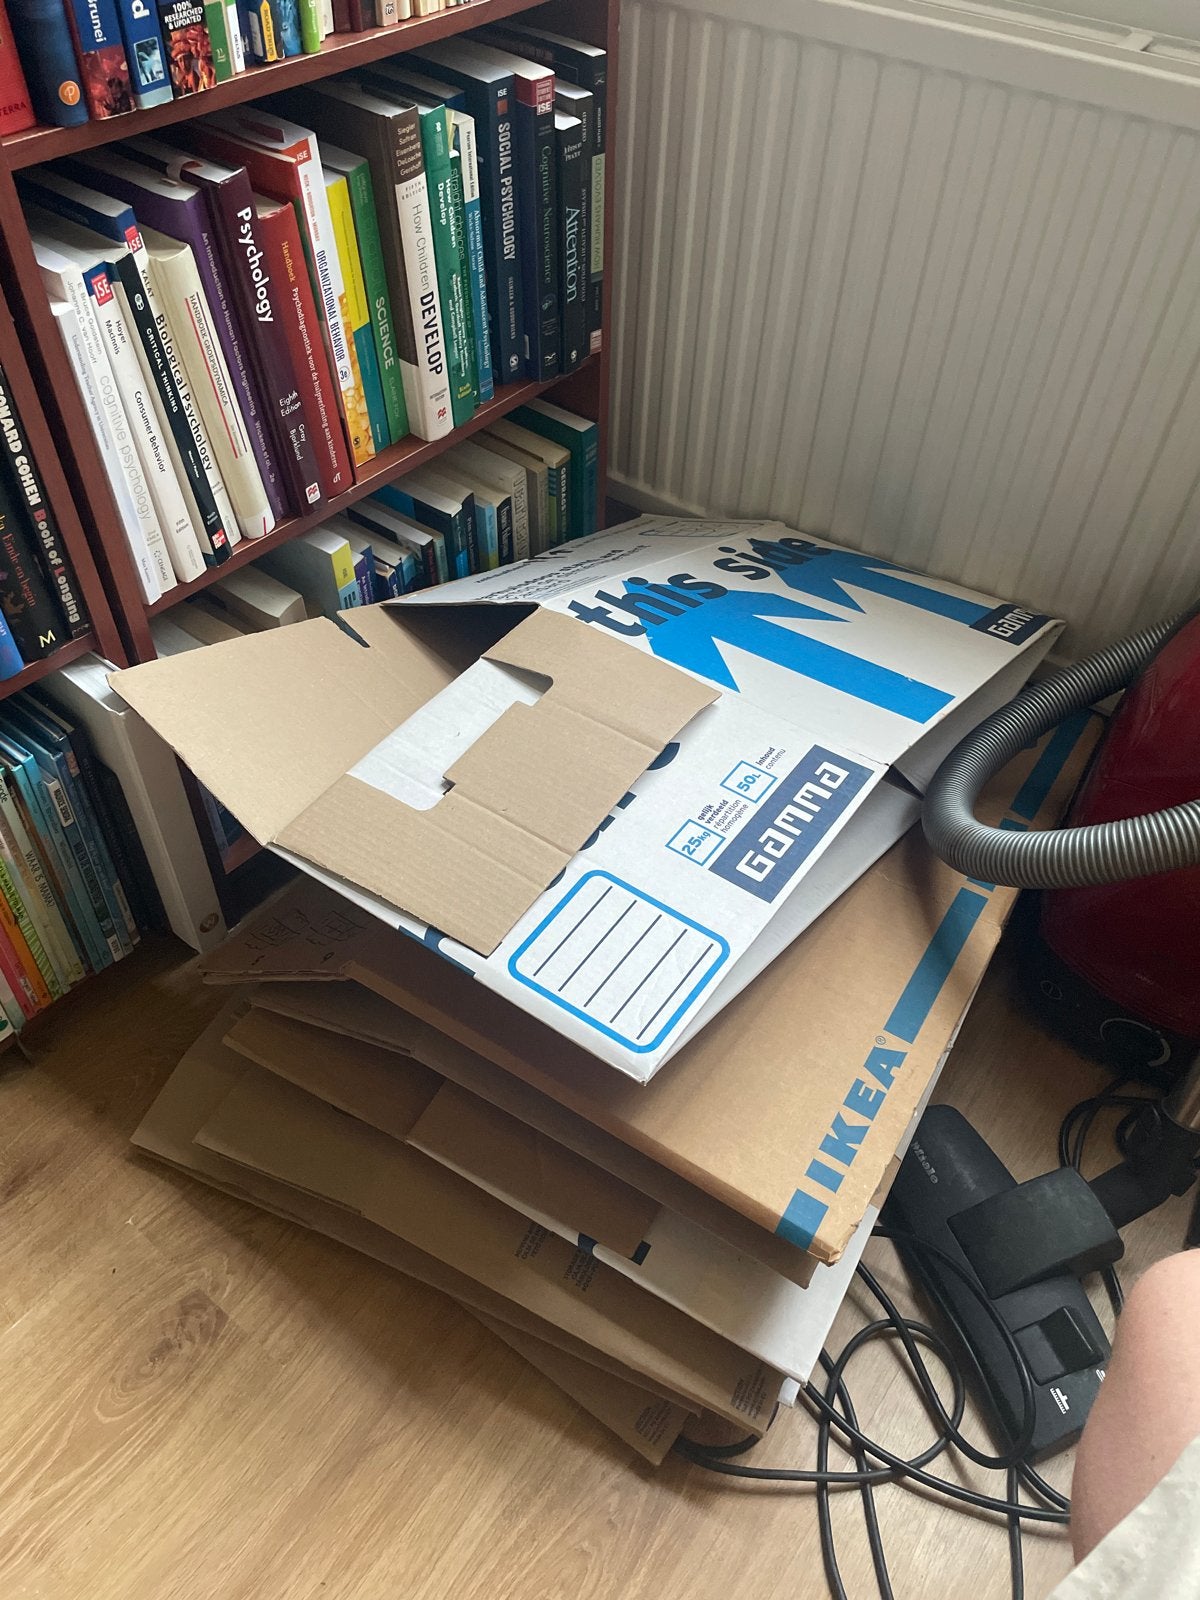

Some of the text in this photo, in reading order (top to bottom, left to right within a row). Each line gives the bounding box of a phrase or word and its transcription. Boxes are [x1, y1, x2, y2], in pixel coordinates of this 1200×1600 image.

[88, 0, 106, 42] runei
[164, 6, 203, 24] RESEARCHED
[168, 15, 202, 30] & UPDATED
[172, 1, 192, 12] 100%
[498, 88, 508, 97] ISE
[538, 102, 551, 112] ISE
[397, 123, 416, 134] Siegler
[296, 150, 308, 161] ISE
[396, 142, 421, 157] Eisenberg
[498, 122, 516, 260] SOCIAL PSYCHOLOGY
[540, 146, 552, 204] Cognitive
[438, 183, 447, 226] Develop
[128, 236, 142, 251] ISE
[472, 210, 483, 249] Abnormal
[543, 208, 552, 284] Neuroscience
[236, 206, 274, 322] Psychology
[475, 251, 484, 272] Child
[566, 206, 581, 302] Attention
[94, 278, 111, 302] ISE
[141, 269, 154, 298] KALAT
[412, 204, 444, 375] How Children DEVELOP
[477, 274, 485, 288] and
[316, 250, 346, 362] ORGANIZATIONAL BEHAVIOR
[116, 320, 126, 344] Hoyer
[202, 232, 208, 242] An
[206, 244, 224, 299] Introduction
[224, 310, 236, 341] Human
[231, 340, 244, 371] Factors
[241, 371, 256, 416] Engineering
[376, 297, 394, 370] SCIENCE
[190, 295, 228, 407] HANDBOEK GROEPSDYNAMICA
[282, 241, 296, 283] Handboek
[292, 287, 312, 356] Psychodiagnostiek
[308, 356, 316, 372] voor
[312, 372, 319, 382] de
[328, 440, 338, 468] kinderen
[146, 328, 179, 414] CRITICAL THINKING
[155, 314, 212, 470] Biological Psychology
[279, 390, 298, 406] Eighth
[281, 402, 301, 417] Edition
[100, 376, 150, 520] cognitive psychology
[134, 390, 166, 473] Consumer Behavior
[298, 424, 306, 442] Gray
[14, 455, 42, 506] COHEN
[34, 508, 54, 548] Book
[48, 550, 63, 565] of
[54, 566, 80, 624] Longing
[568, 574, 728, 639] this
[713, 538, 832, 580] side
[765, 748, 786, 770] contenu
[736, 772, 762, 792] 50L
[698, 803, 714, 821] gelijk
[704, 799, 729, 825] verdeeld
[713, 798, 742, 830] répartition
[720, 804, 749, 834] homogène
[24, 850, 55, 908] WAAR IS MAMA?
[804, 1044, 908, 1194] IKEA
